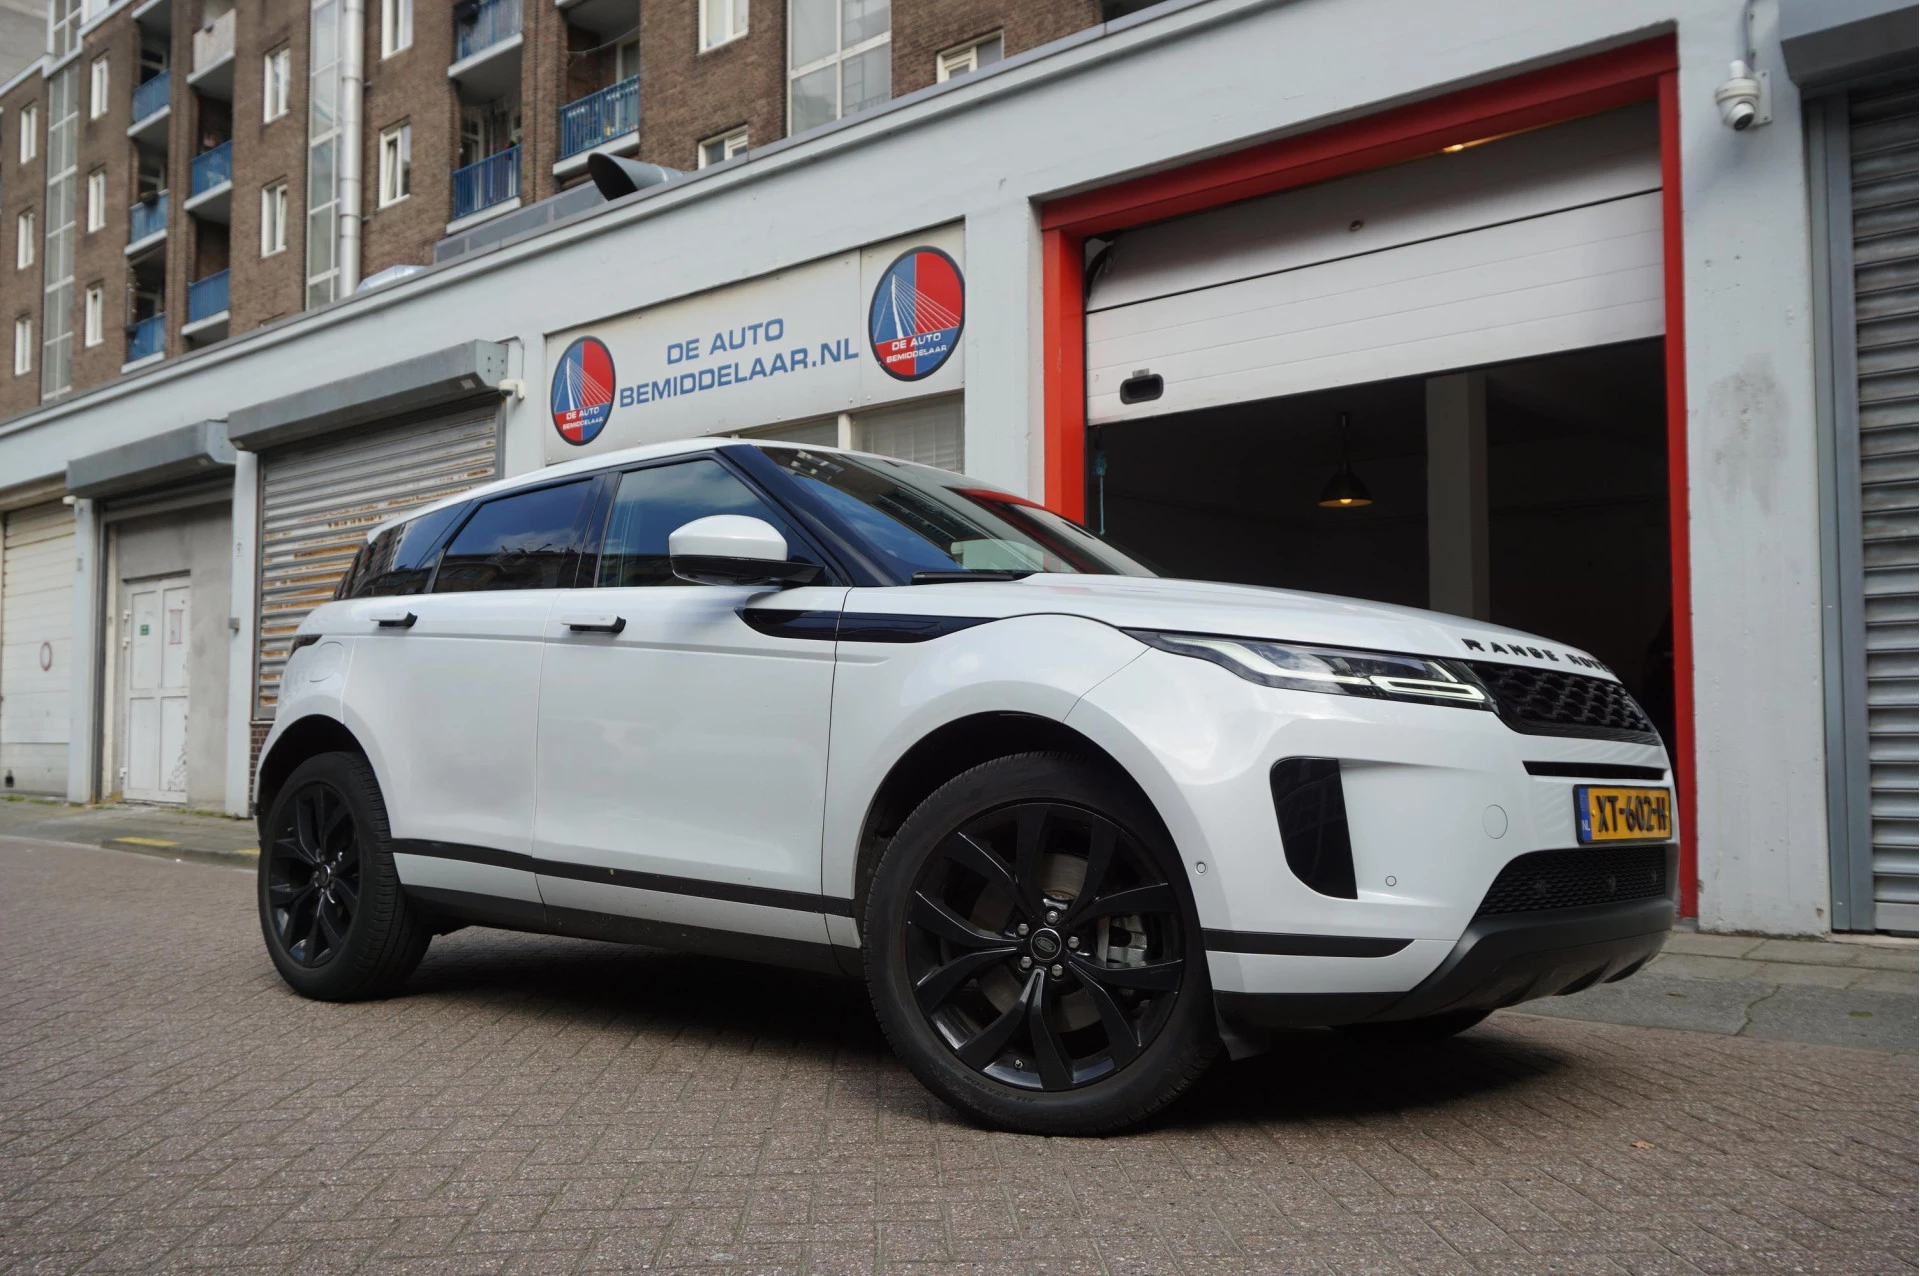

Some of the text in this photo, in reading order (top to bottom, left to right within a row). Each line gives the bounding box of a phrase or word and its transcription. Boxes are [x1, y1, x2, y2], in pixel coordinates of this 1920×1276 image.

[667, 318, 784, 365] DE AUTO
[891, 332, 941, 351] DE AUTO
[886, 345, 947, 363] BEMIDDELAAR
[620, 337, 859, 408] BEMIDDELAAR.NL
[566, 406, 600, 420] DE AUTO
[562, 417, 604, 430] BEMIDDELAAR
[1461, 638, 1613, 674] RANGE ROVE
[1595, 795, 1667, 833] XT-602-H
[1581, 819, 1592, 832] NL
